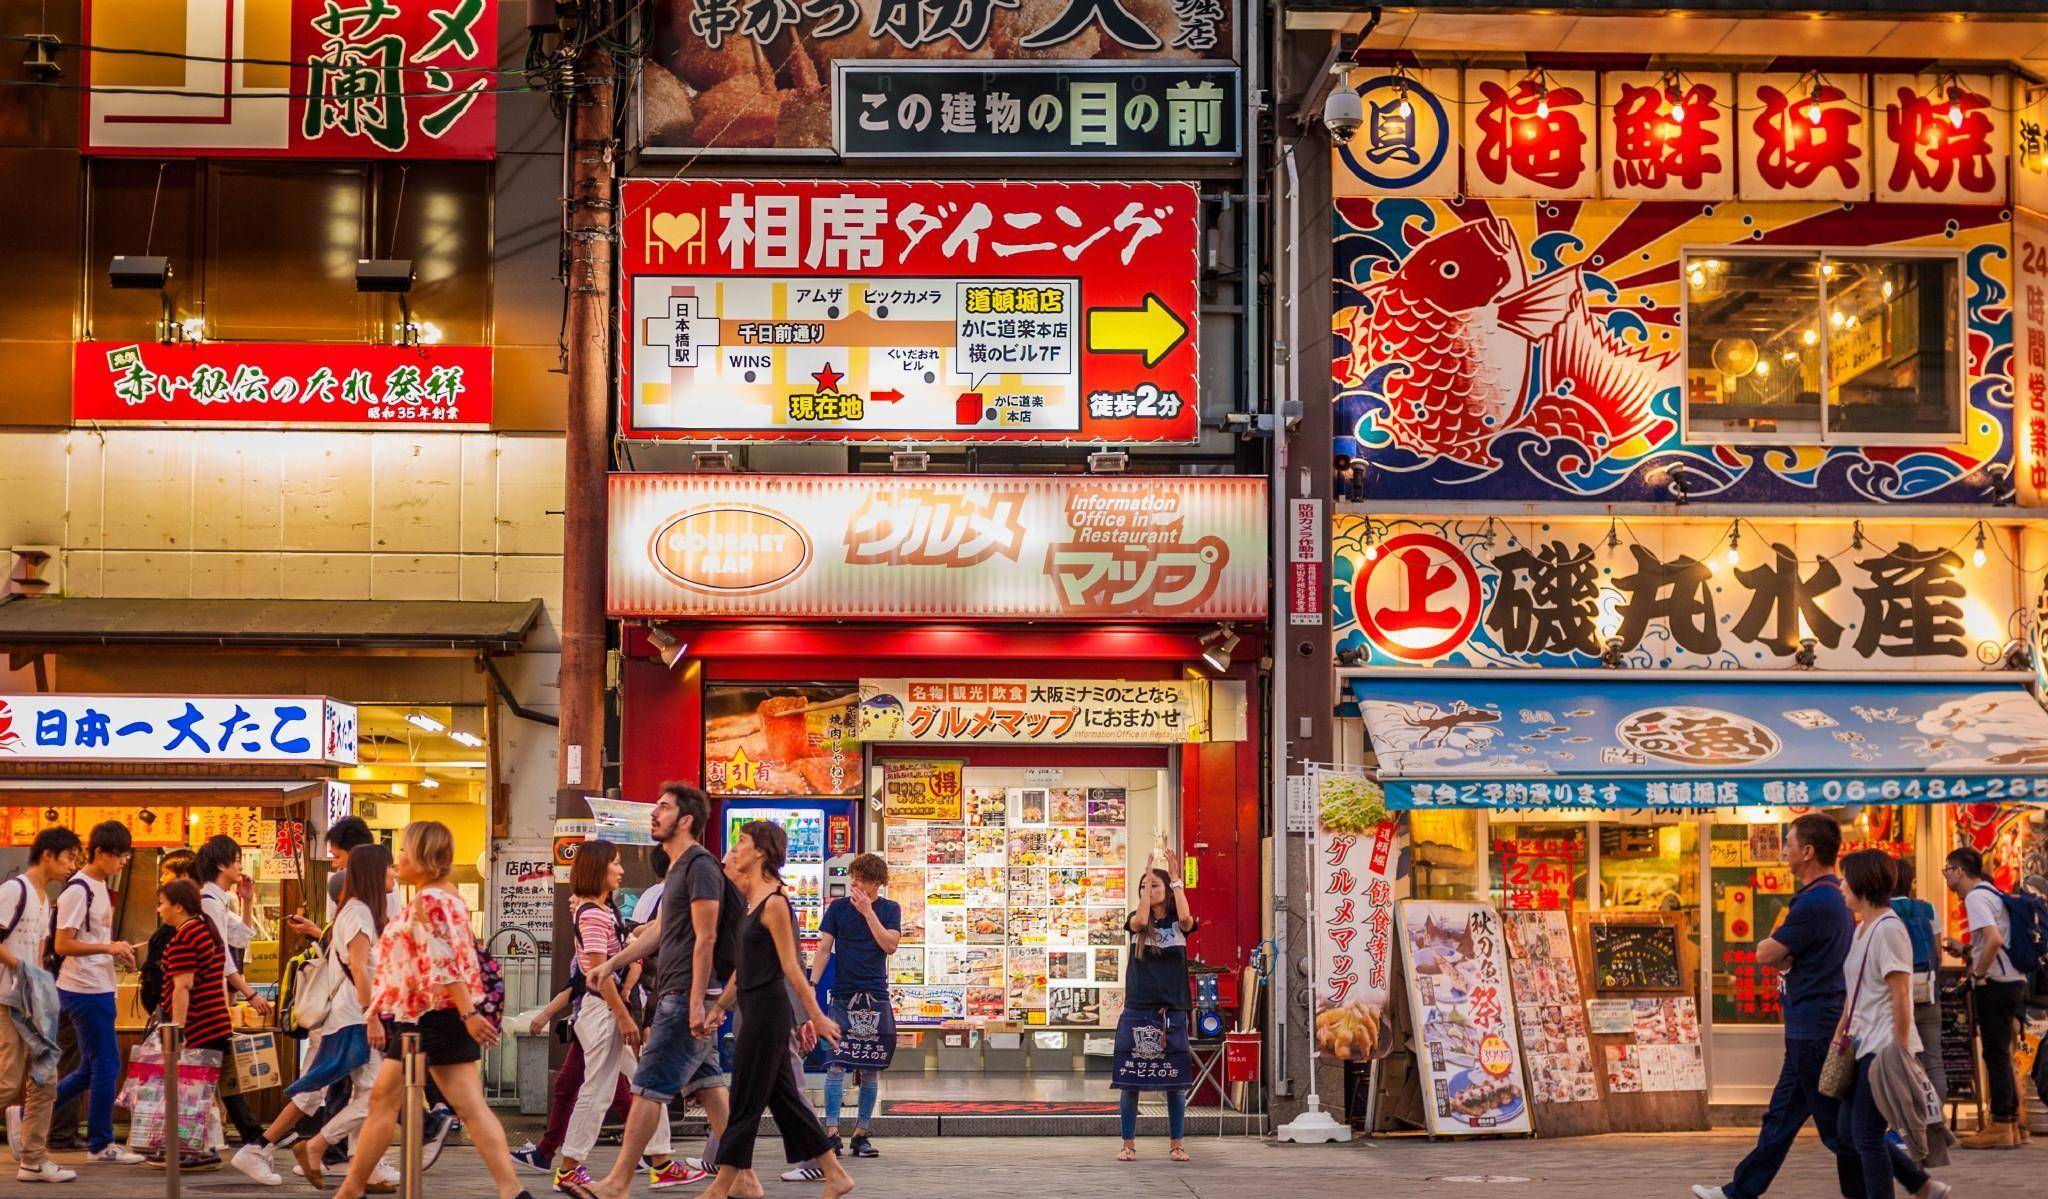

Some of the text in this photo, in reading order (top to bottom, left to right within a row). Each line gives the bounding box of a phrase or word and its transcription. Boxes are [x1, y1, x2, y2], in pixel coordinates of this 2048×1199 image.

[858, 81, 1225, 147] この建物の目の前
[717, 192, 1174, 272] 相席ダイニング
[796, 288, 843, 304] アムザ
[863, 288, 942, 304] ビックカメラ
[965, 286, 1066, 315] 道頓堀店
[674, 303, 690, 363] 日本橋駅
[738, 323, 825, 344] 千日前通り
[961, 319, 1068, 339] かに道楽本店
[730, 356, 771, 368] WINS
[887, 349, 940, 361] くいだおれ
[968, 344, 1062, 364] 横のビル7F
[902, 360, 925, 372] ビル
[789, 394, 865, 421] 現在地
[994, 395, 1044, 408] かに道楽
[1088, 382, 1183, 420] 徒歩2分
[367, 407, 460, 420] 昭和35年創業
[1006, 410, 1032, 424] 本店
[1071, 494, 1177, 511] Information
[852, 488, 1021, 563] グルメ
[1072, 511, 1149, 527] Office in
[1078, 527, 1179, 544] Restaurant
[1298, 503, 1314, 560] 防犯カメラ作動中
[668, 533, 787, 553] GOURMET
[701, 555, 754, 574] MAP
[1053, 545, 1220, 606] マップ
[1490, 540, 1968, 659] 磯丸水産
[911, 686, 1179, 703] 名物 観光 飲食 大阪ミナミのことなら
[35, 701, 311, 754] 日本一大たこ
[908, 705, 1181, 739] グルメマップ におまかせ
[709, 761, 773, 783] 割引有
[1411, 783, 1622, 805] 宴会ご予約承ります
[1645, 782, 1739, 804] 道頓堀店
[1762, 781, 1810, 803] 電話
[1374, 828, 1392, 868] 道頓堀
[1326, 834, 1358, 1003] グルメマップ
[1363, 880, 1390, 990] 飲食案内
[834, 1049, 888, 1061] サービスの店
[1124, 1060, 1173, 1069] 親切本位
[1119, 1067, 1179, 1078] サービスの店
